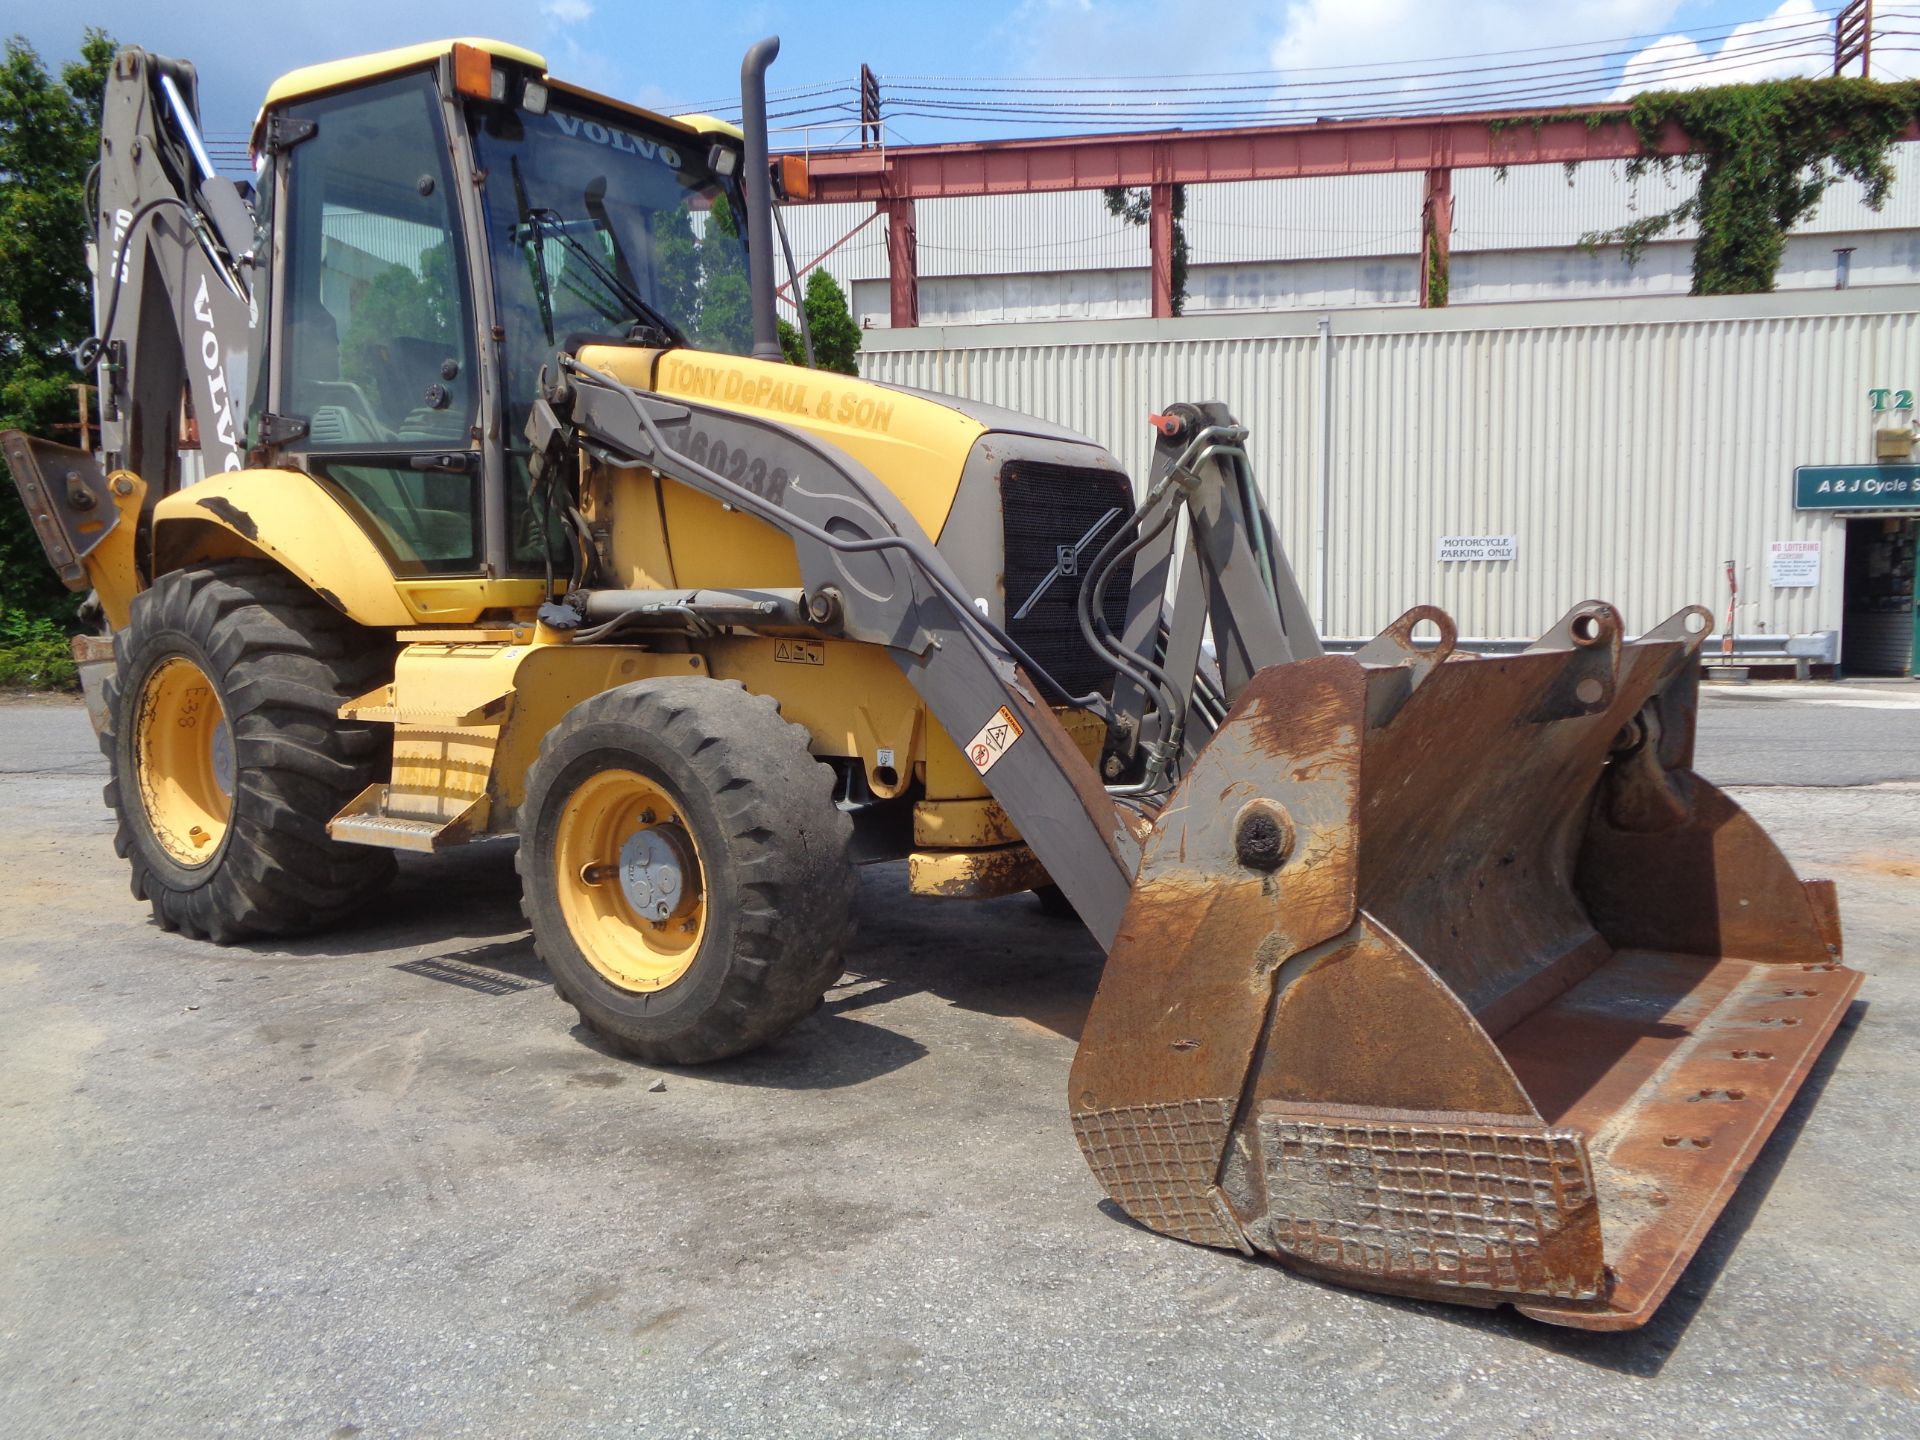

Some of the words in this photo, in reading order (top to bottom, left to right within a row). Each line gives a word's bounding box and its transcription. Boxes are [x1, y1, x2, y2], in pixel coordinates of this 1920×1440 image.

[550, 110, 683, 169] VOLVO
[668, 358, 725, 395] TONY
[815, 390, 834, 421] &
[836, 391, 895, 433] SON
[1817, 480, 1831, 493] A
[1834, 480, 1846, 493] &
[1849, 480, 1861, 493] J
[1863, 479, 1907, 496] Cycle
[1443, 538, 1509, 547] MOTORCYCLE
[1771, 543, 1782, 552] NO
[1784, 542, 1819, 552] LOITERING
[1440, 549, 1484, 558] PARKING
[1487, 548, 1512, 557] ONLY
